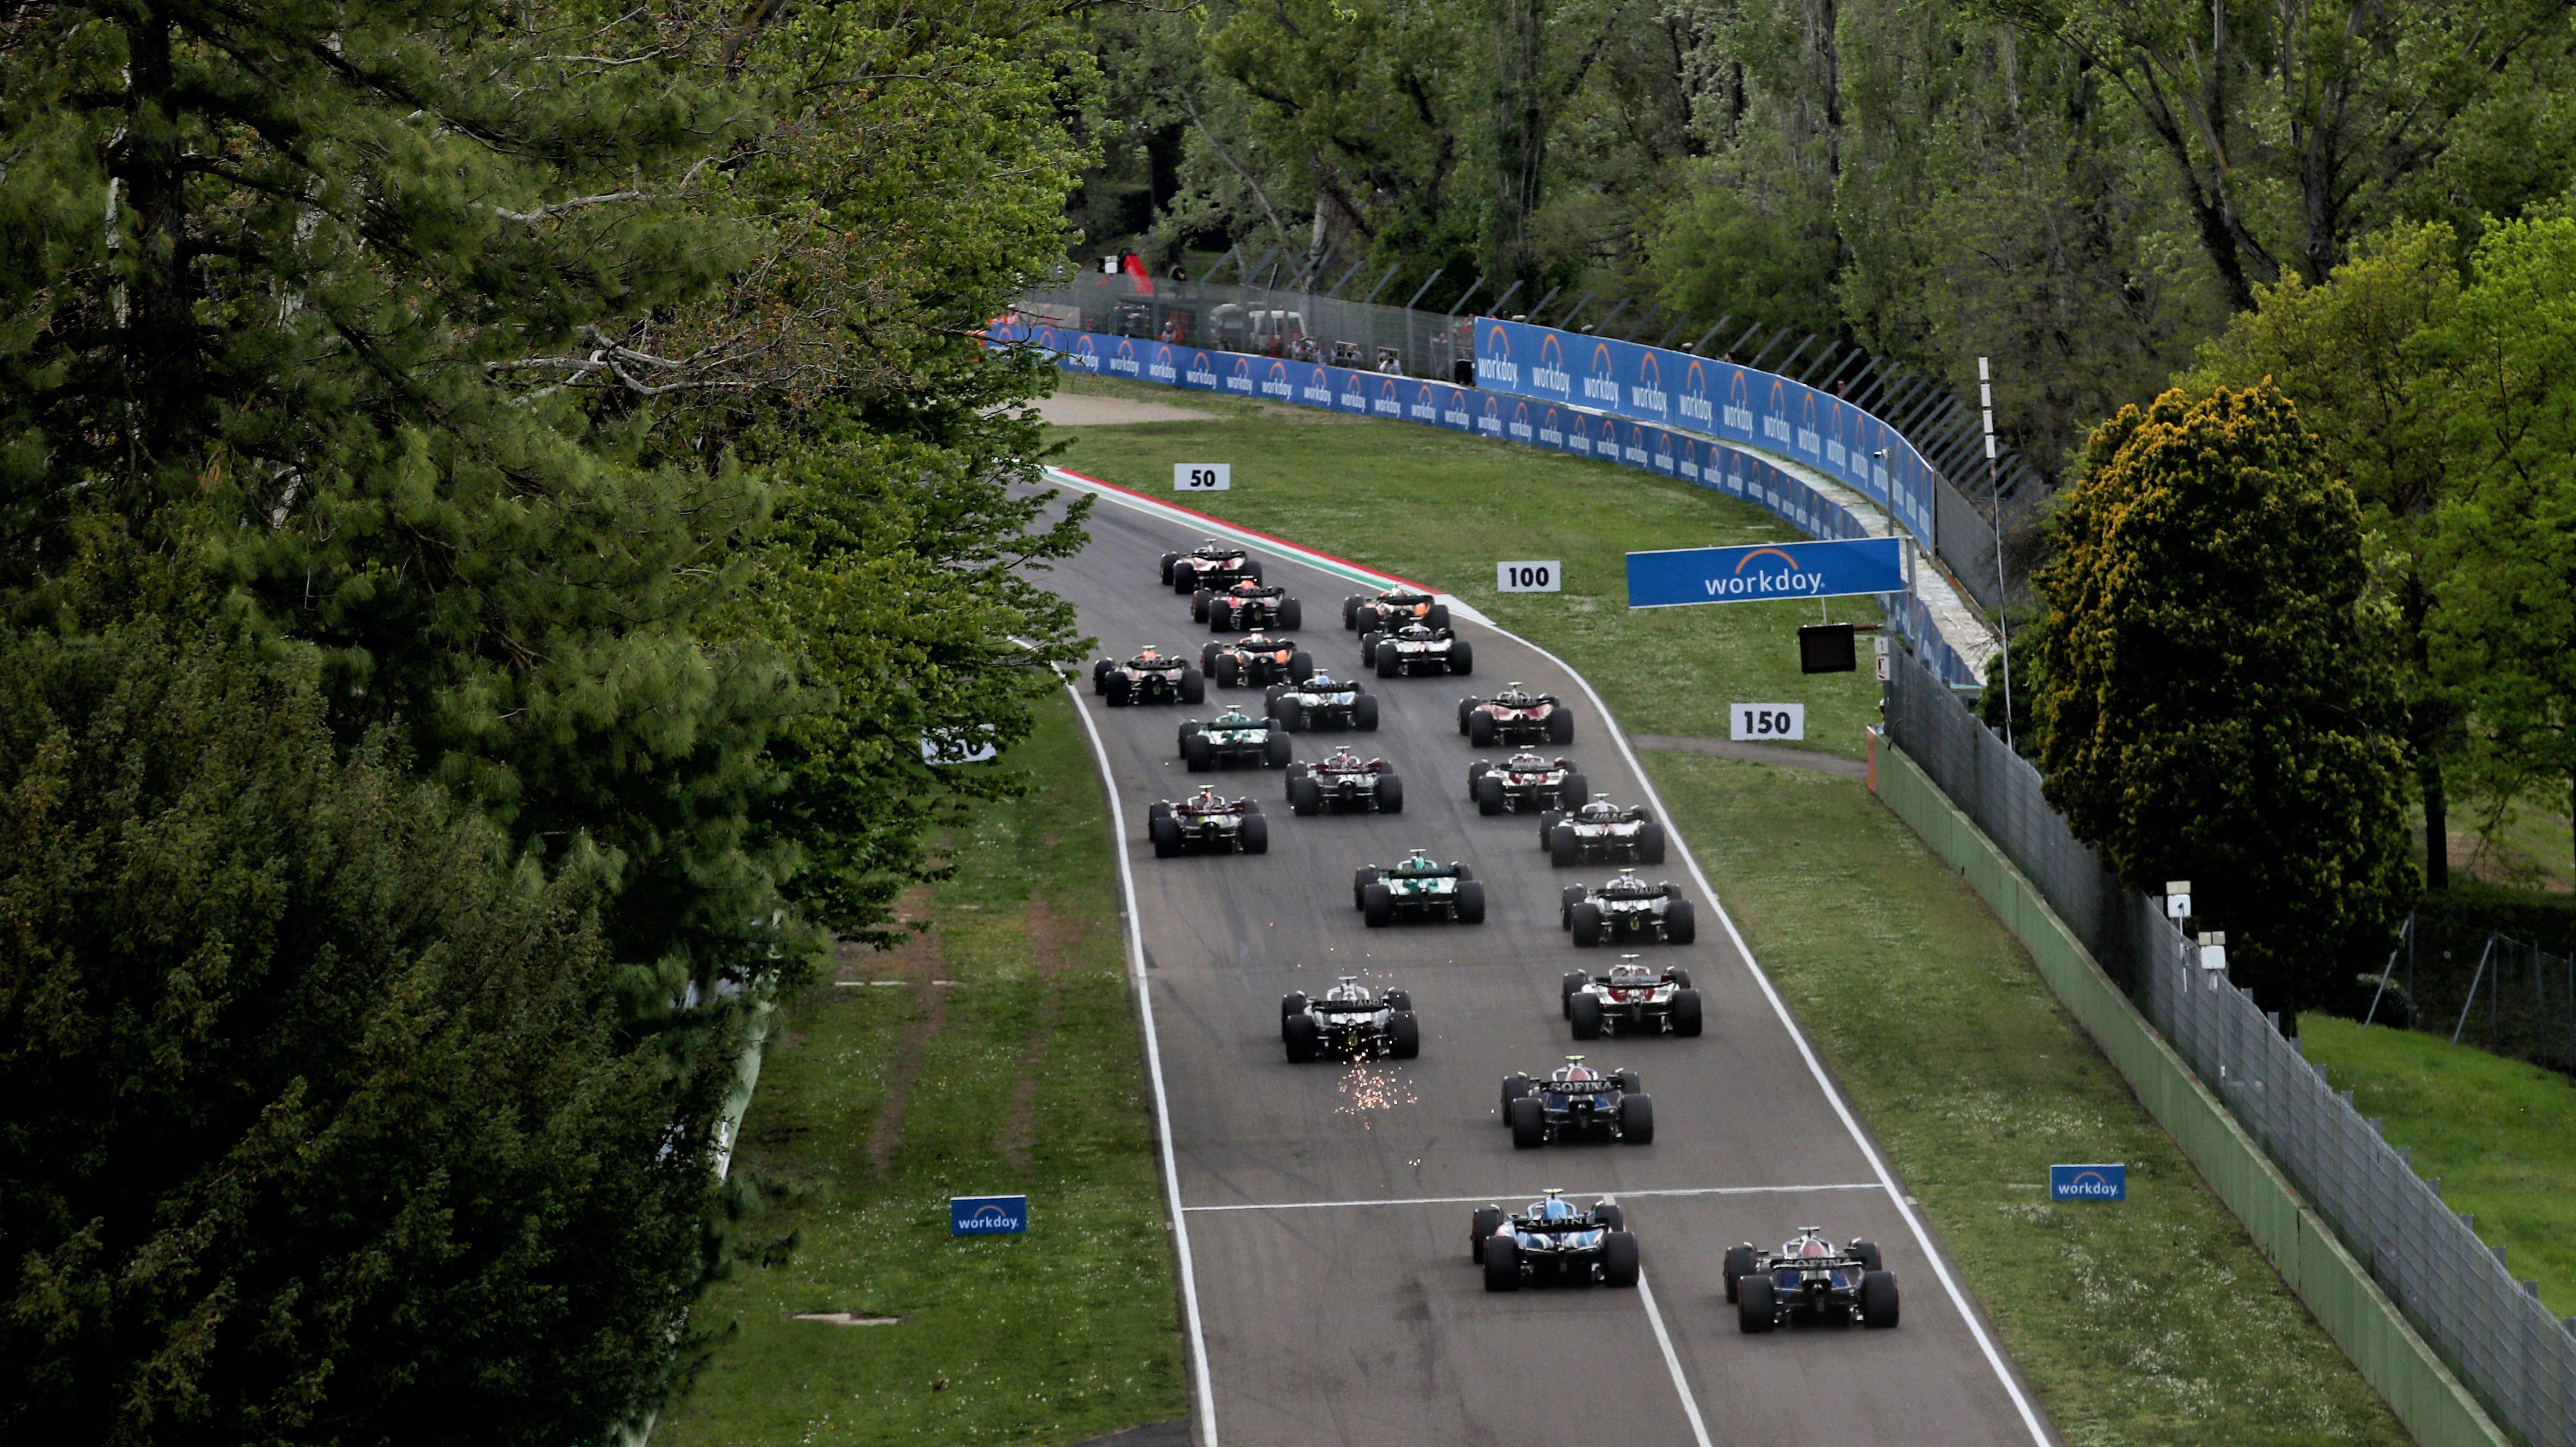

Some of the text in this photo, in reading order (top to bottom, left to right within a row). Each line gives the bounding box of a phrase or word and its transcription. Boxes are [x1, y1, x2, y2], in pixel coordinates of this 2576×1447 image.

[1477, 352, 1518, 390] workday
[1190, 469, 1216, 487] 50
[1509, 567, 1549, 587] 100
[1744, 711, 1791, 735] 150
[1550, 1081, 1614, 1092] SOFINA
[1527, 1217, 1596, 1227] ALPINE
